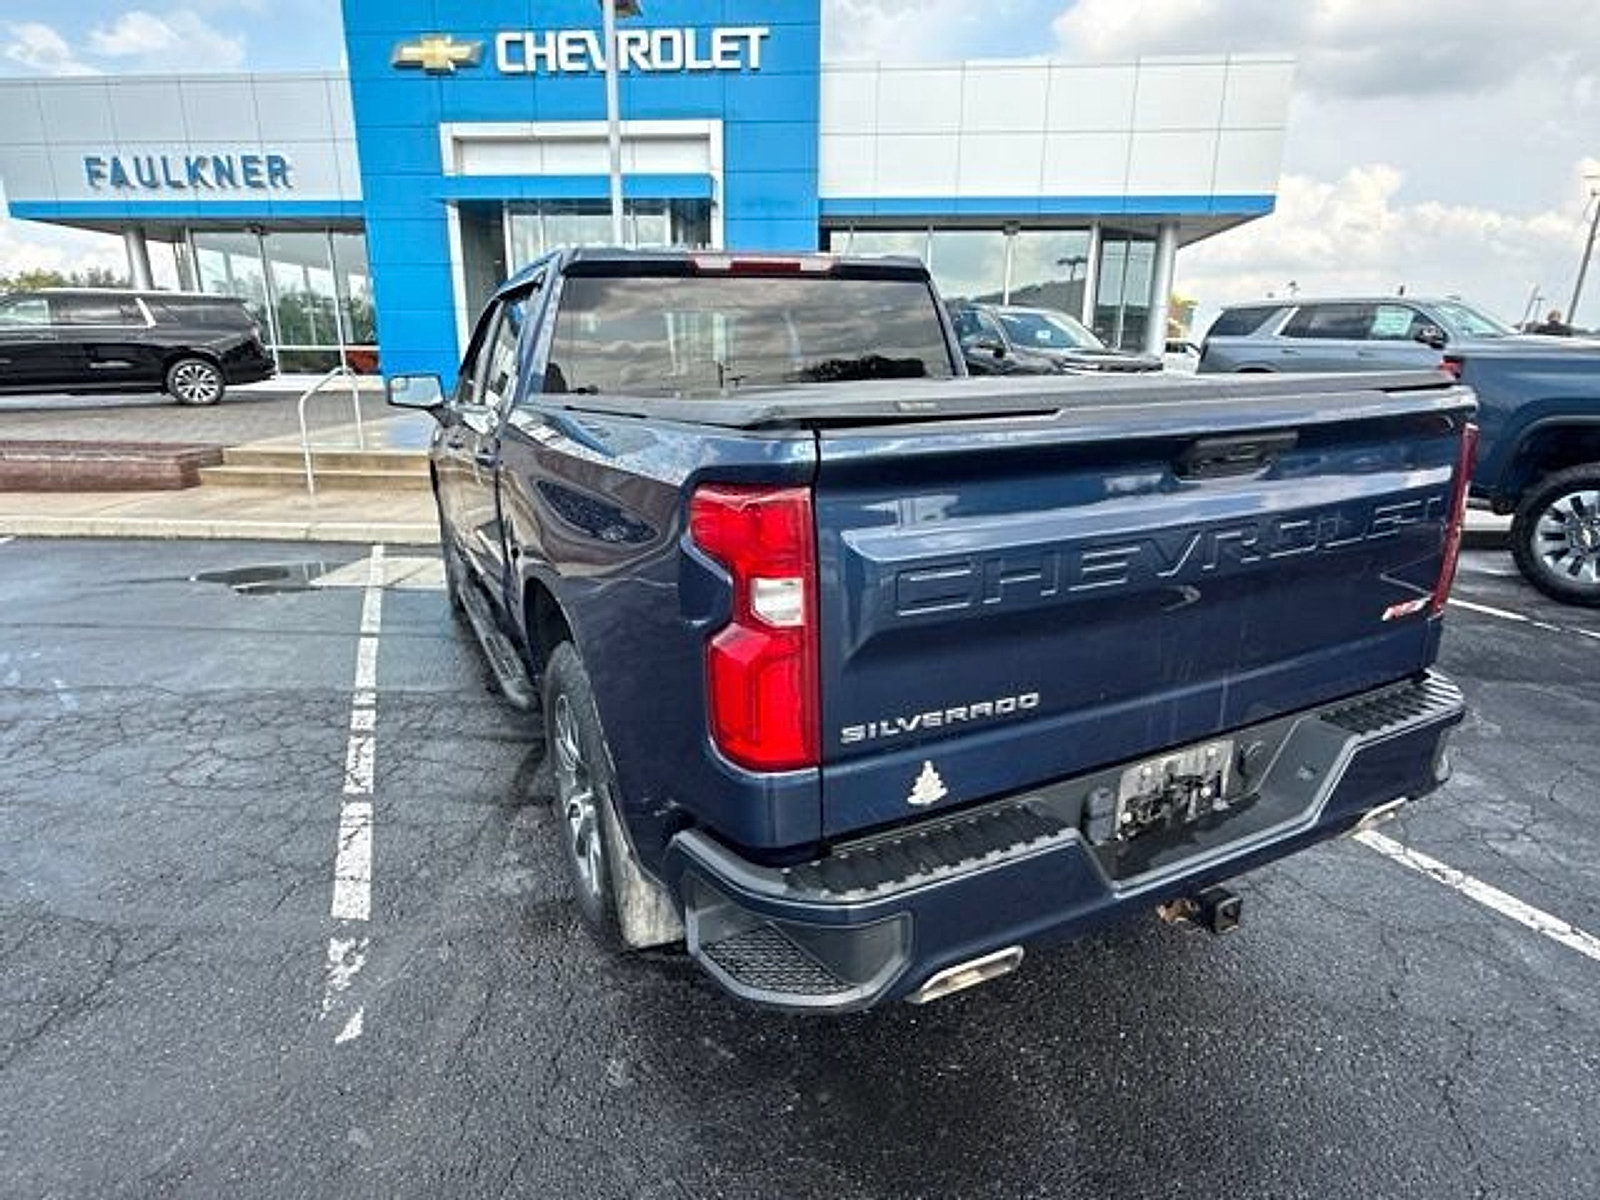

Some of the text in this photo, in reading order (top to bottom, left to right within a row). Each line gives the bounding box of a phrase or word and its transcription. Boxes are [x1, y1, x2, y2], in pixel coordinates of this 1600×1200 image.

[495, 27, 769, 72] CHEVROLET
[84, 155, 292, 188] FAULKNER
[840, 692, 1040, 743] SILVERADO
